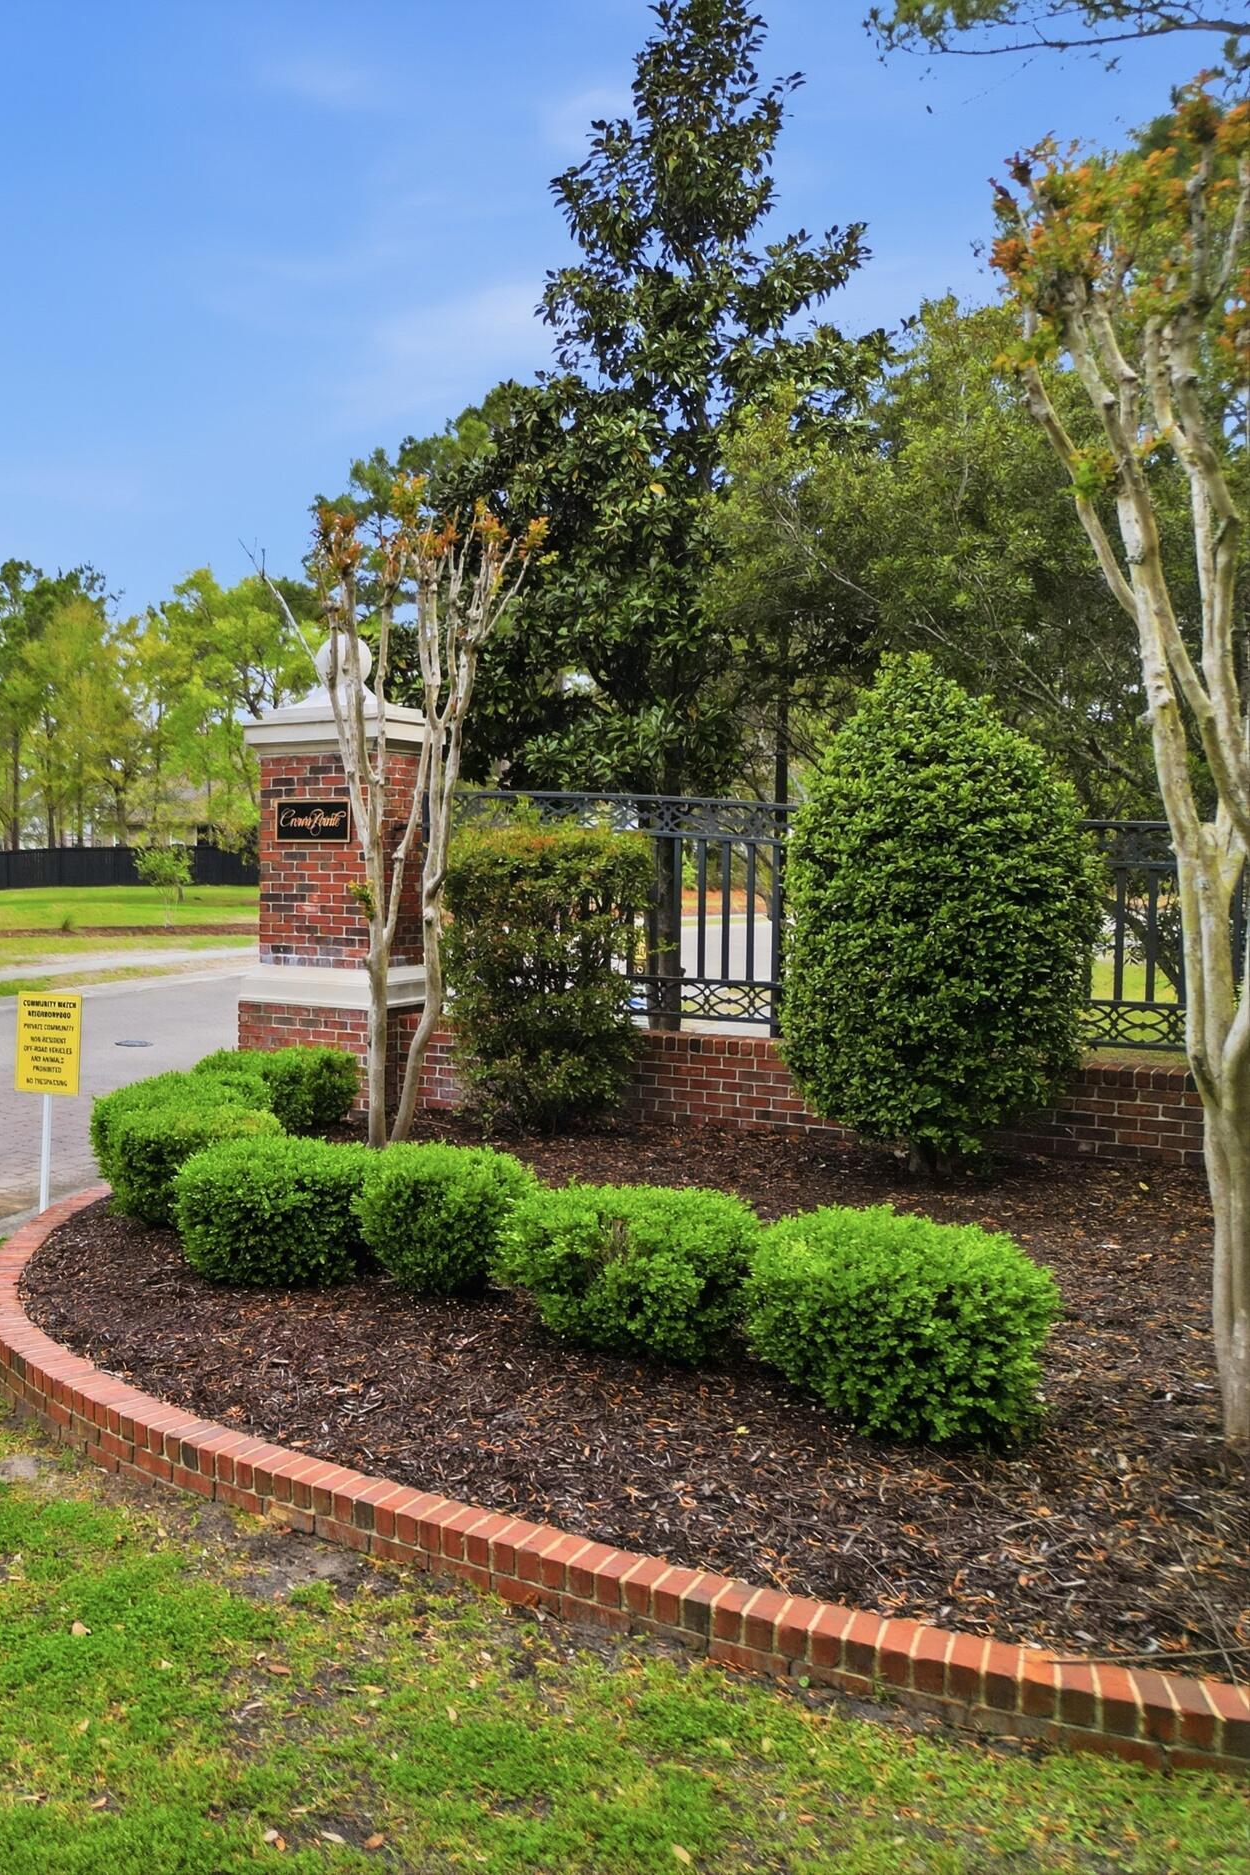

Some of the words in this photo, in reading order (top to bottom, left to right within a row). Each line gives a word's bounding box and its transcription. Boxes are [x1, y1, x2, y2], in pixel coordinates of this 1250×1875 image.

[280, 808, 311, 829] Crown
[27, 1010, 71, 1019] NEIGHBORHOOD
[43, 1024, 74, 1032] COMMUNITY
[48, 1046, 72, 1055] VEHICLES
[42, 1056, 64, 1064] ANIMALS
[32, 1065, 62, 1073] PROHIBITED
[34, 1078, 68, 1087] TRESPASSING
